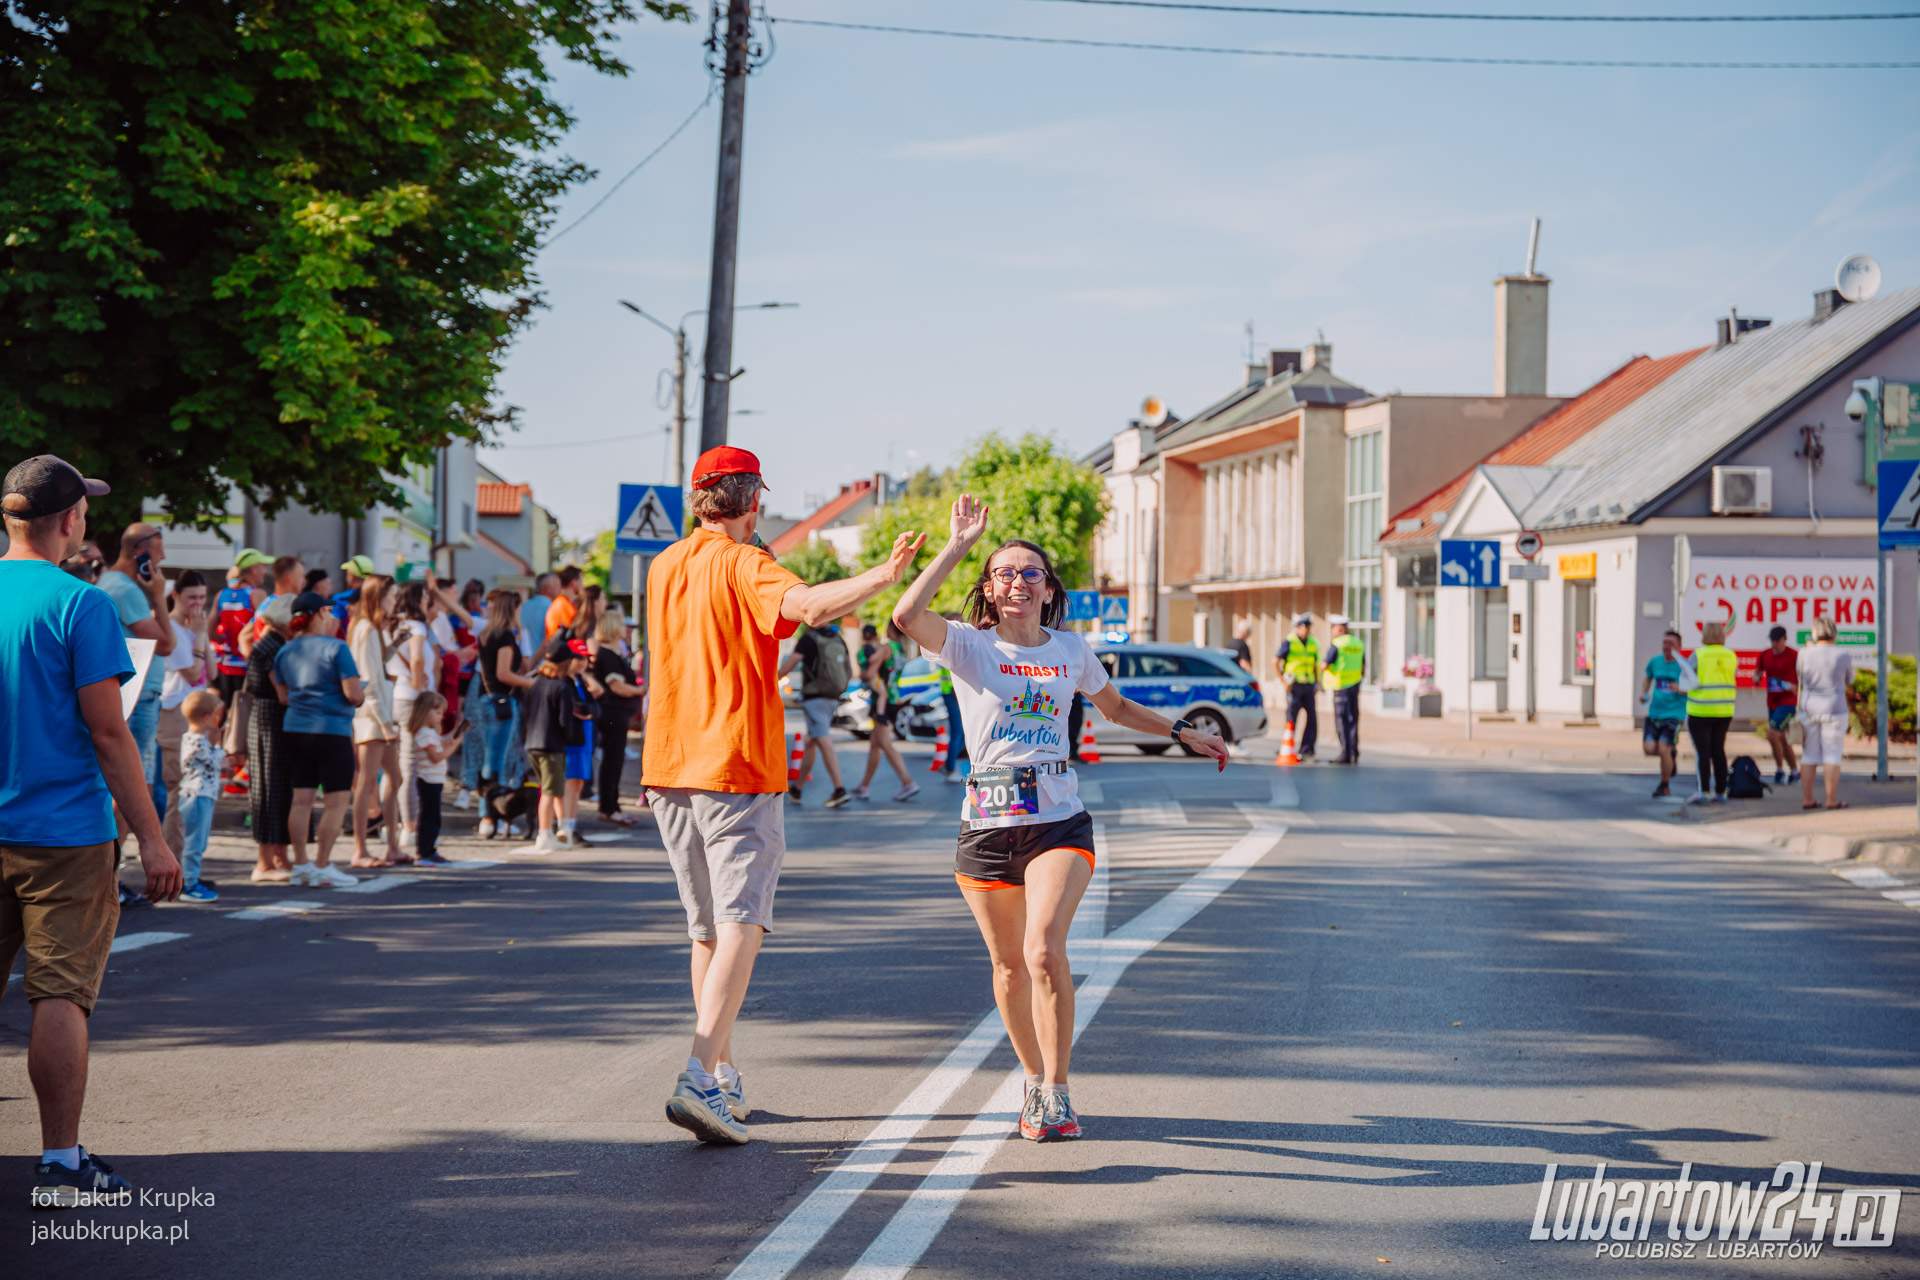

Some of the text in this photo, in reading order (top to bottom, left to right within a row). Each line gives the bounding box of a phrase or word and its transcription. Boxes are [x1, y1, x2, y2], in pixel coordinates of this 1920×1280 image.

[1695, 574, 1875, 591] CAŁODOBOWA
[1746, 596, 1875, 624] APTEKA
[1000, 664, 1059, 677] ULTRASY
[991, 721, 1061, 746] Lubartów
[980, 783, 1025, 807] 201
